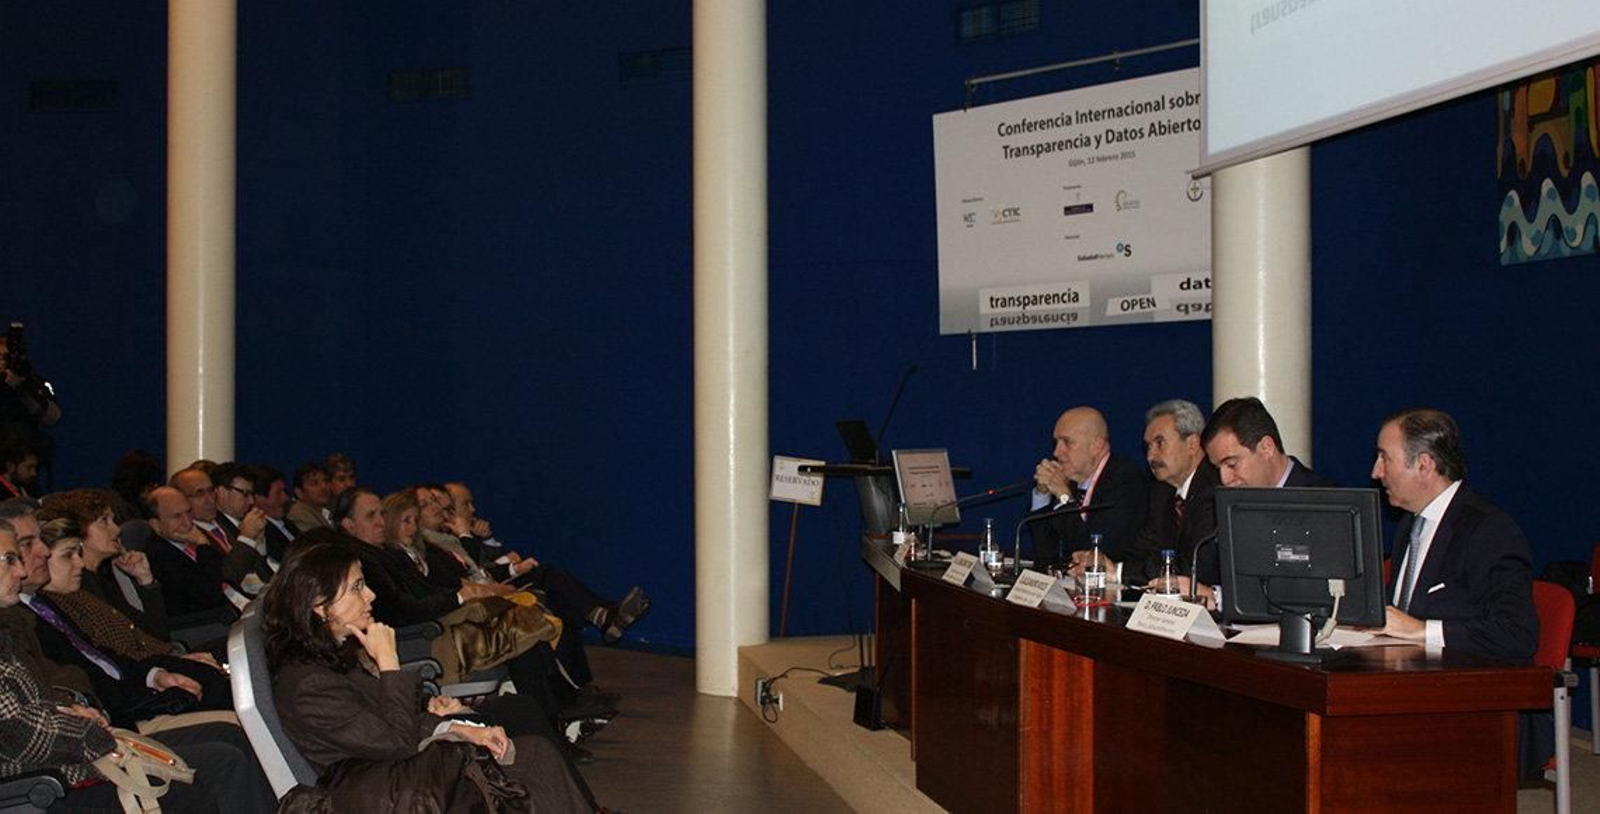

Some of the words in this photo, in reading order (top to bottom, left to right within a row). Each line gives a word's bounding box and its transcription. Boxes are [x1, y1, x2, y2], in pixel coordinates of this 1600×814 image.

[998, 112, 1072, 137] Conferencia
[1075, 98, 1166, 125] Internacional
[1002, 133, 1091, 159] Transparencia
[1094, 133, 1102, 148] y
[1105, 124, 1145, 144] Datos
[1148, 118, 1201, 138] Abierto
[990, 287, 1080, 310] transparencia
[1120, 296, 1157, 312] OPEN
[775, 473, 819, 486] RESERVADO
